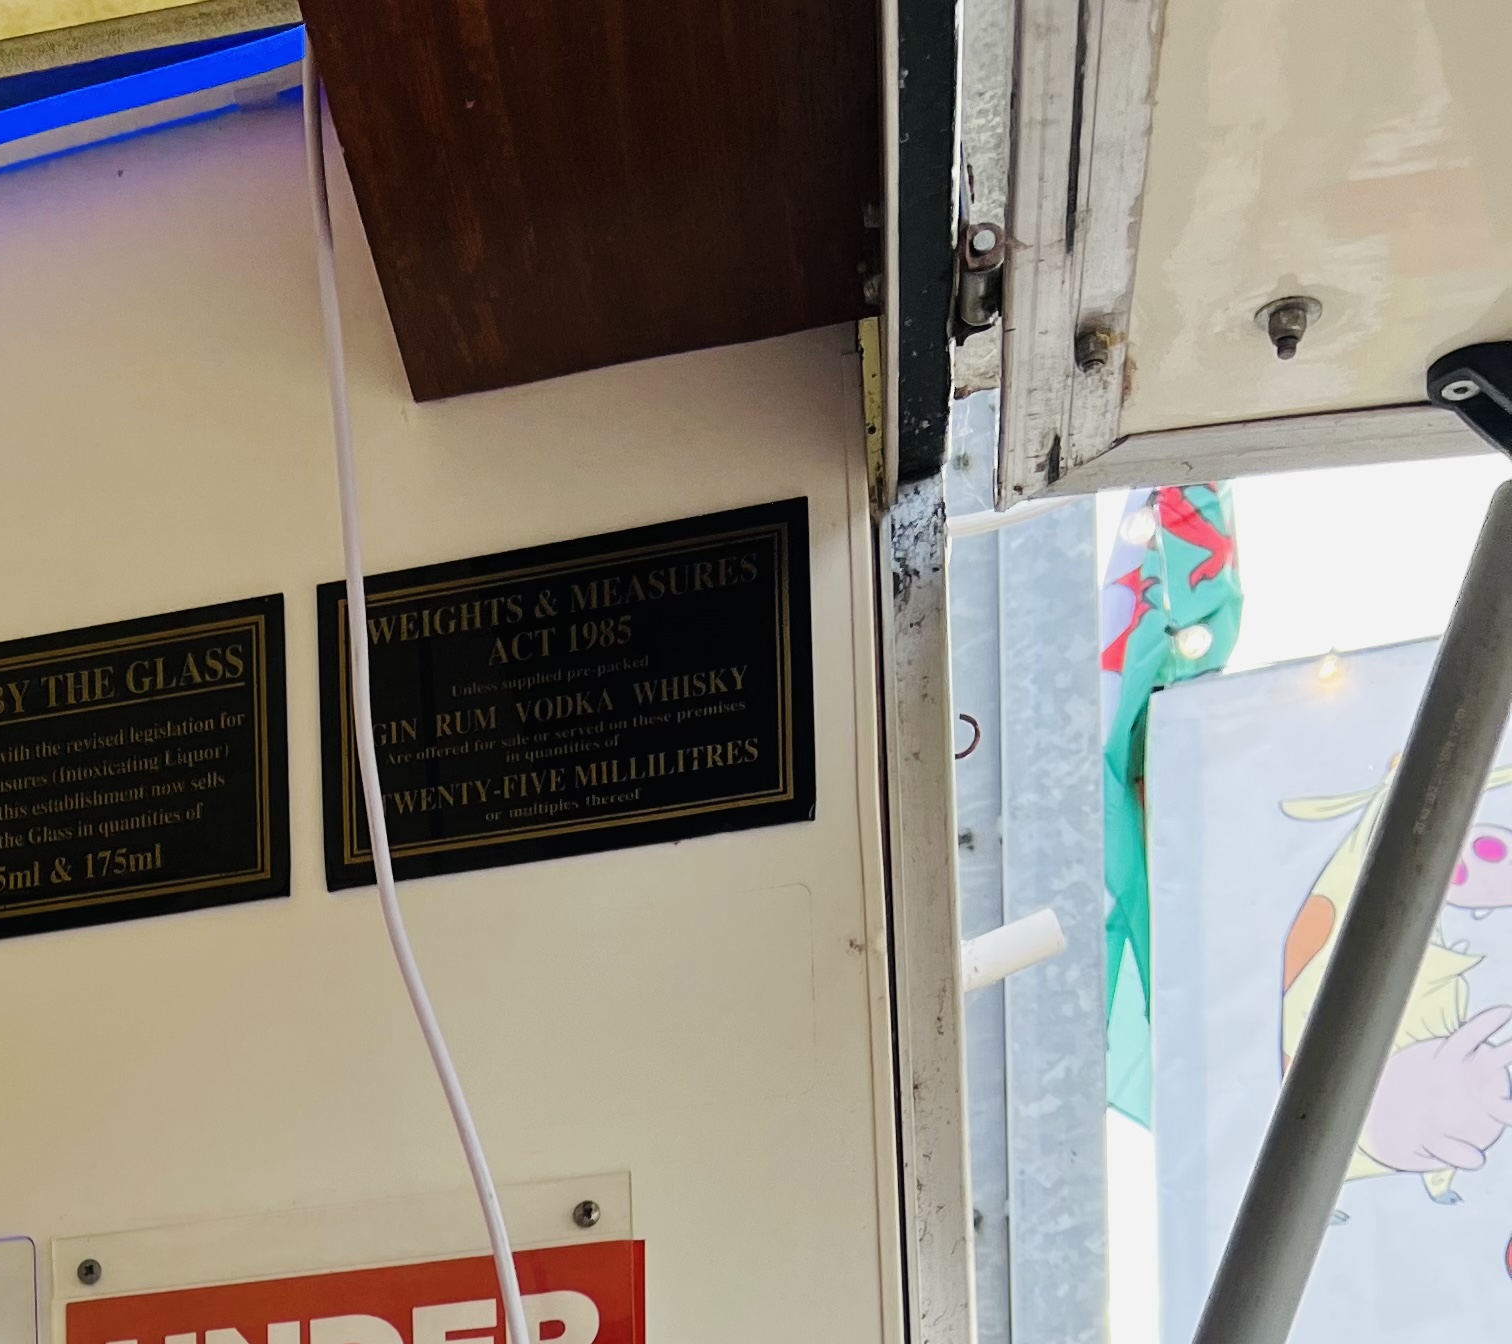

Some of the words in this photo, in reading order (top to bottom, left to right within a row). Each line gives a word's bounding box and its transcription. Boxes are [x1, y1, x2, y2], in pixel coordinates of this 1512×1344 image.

[368, 594, 522, 646] WEIGHTS
[534, 589, 557, 619] &
[570, 553, 757, 612] MEASURES
[488, 627, 556, 665] ACT
[569, 615, 632, 652] 1985
[40, 666, 115, 707] THE
[126, 644, 244, 693] GLASS
[501, 668, 562, 691] supplied
[373, 717, 418, 747] GIN
[436, 706, 497, 737] RUM
[516, 688, 614, 723] VODKA
[633, 664, 748, 706] WHISKY
[35, 741, 61, 759] the
[66, 728, 125, 753] revised
[130, 716, 215, 745] legislation
[220, 711, 246, 729] for
[416, 740, 469, 761] offered
[474, 738, 497, 753] for
[501, 732, 530, 748] sale
[534, 730, 551, 743] or
[633, 712, 672, 728] these
[677, 699, 746, 723] premises
[525, 738, 601, 763] quantities
[605, 733, 620, 748] of
[575, 737, 759, 789] MILLILITRES
[32, 785, 145, 816] establishment
[151, 781, 185, 798] now
[191, 771, 226, 791] sells
[485, 808, 502, 822] or
[509, 798, 579, 820] multiples
[28, 825, 74, 846] Glass
[78, 819, 94, 838] in
[99, 808, 181, 838] quantities
[186, 801, 204, 822] of
[50, 856, 72, 884] &
[85, 842, 164, 879] 175ml
